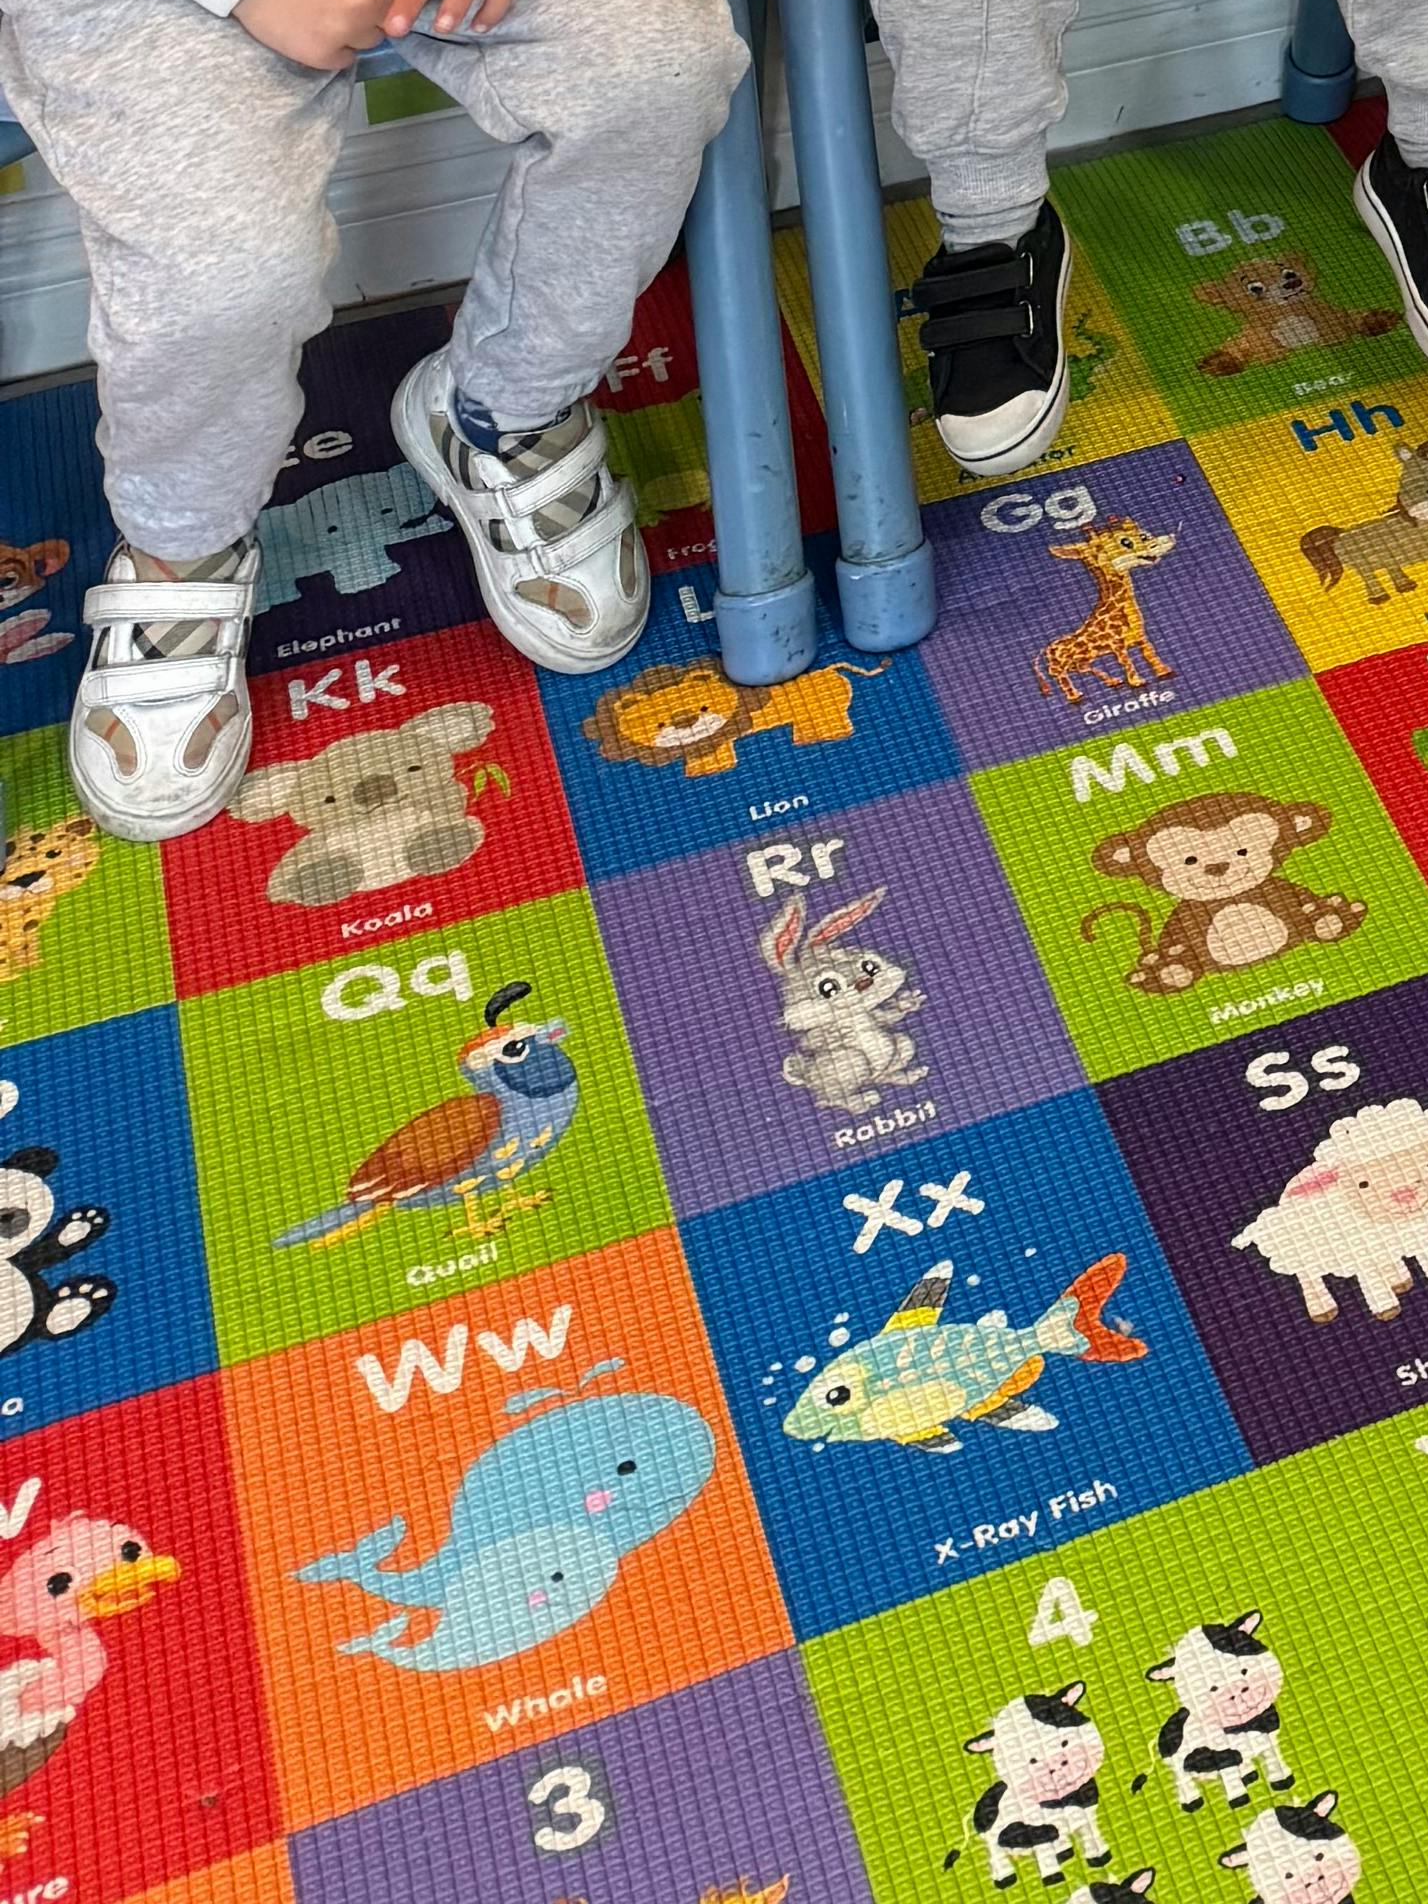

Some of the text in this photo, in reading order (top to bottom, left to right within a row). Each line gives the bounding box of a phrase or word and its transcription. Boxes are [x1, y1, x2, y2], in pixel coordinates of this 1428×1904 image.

[1174, 209, 1286, 257] Bb
[606, 346, 674, 393] Ff
[1291, 399, 1404, 454] Hh
[980, 484, 1099, 535] Gg
[275, 616, 403, 659] Elephant
[286, 659, 407, 721] Kk
[1083, 687, 1175, 726] Giraffe
[1068, 727, 1239, 804] Mm
[749, 794, 810, 823] Lion
[744, 836, 845, 899] Rr
[339, 899, 435, 940] Koala
[319, 950, 473, 1023] Qq
[1209, 976, 1326, 1026] Monkey
[1245, 1044, 1361, 1112] Ss
[834, 1101, 937, 1150] Rabbit
[842, 1169, 986, 1255] Xx
[405, 1240, 500, 1288] Quail
[354, 1303, 574, 1415] Ww
[933, 1479, 1119, 1567] X-Ray Fish
[1027, 1576, 1100, 1649] 4
[483, 1672, 609, 1733] Whale
[527, 1764, 606, 1853] 3
